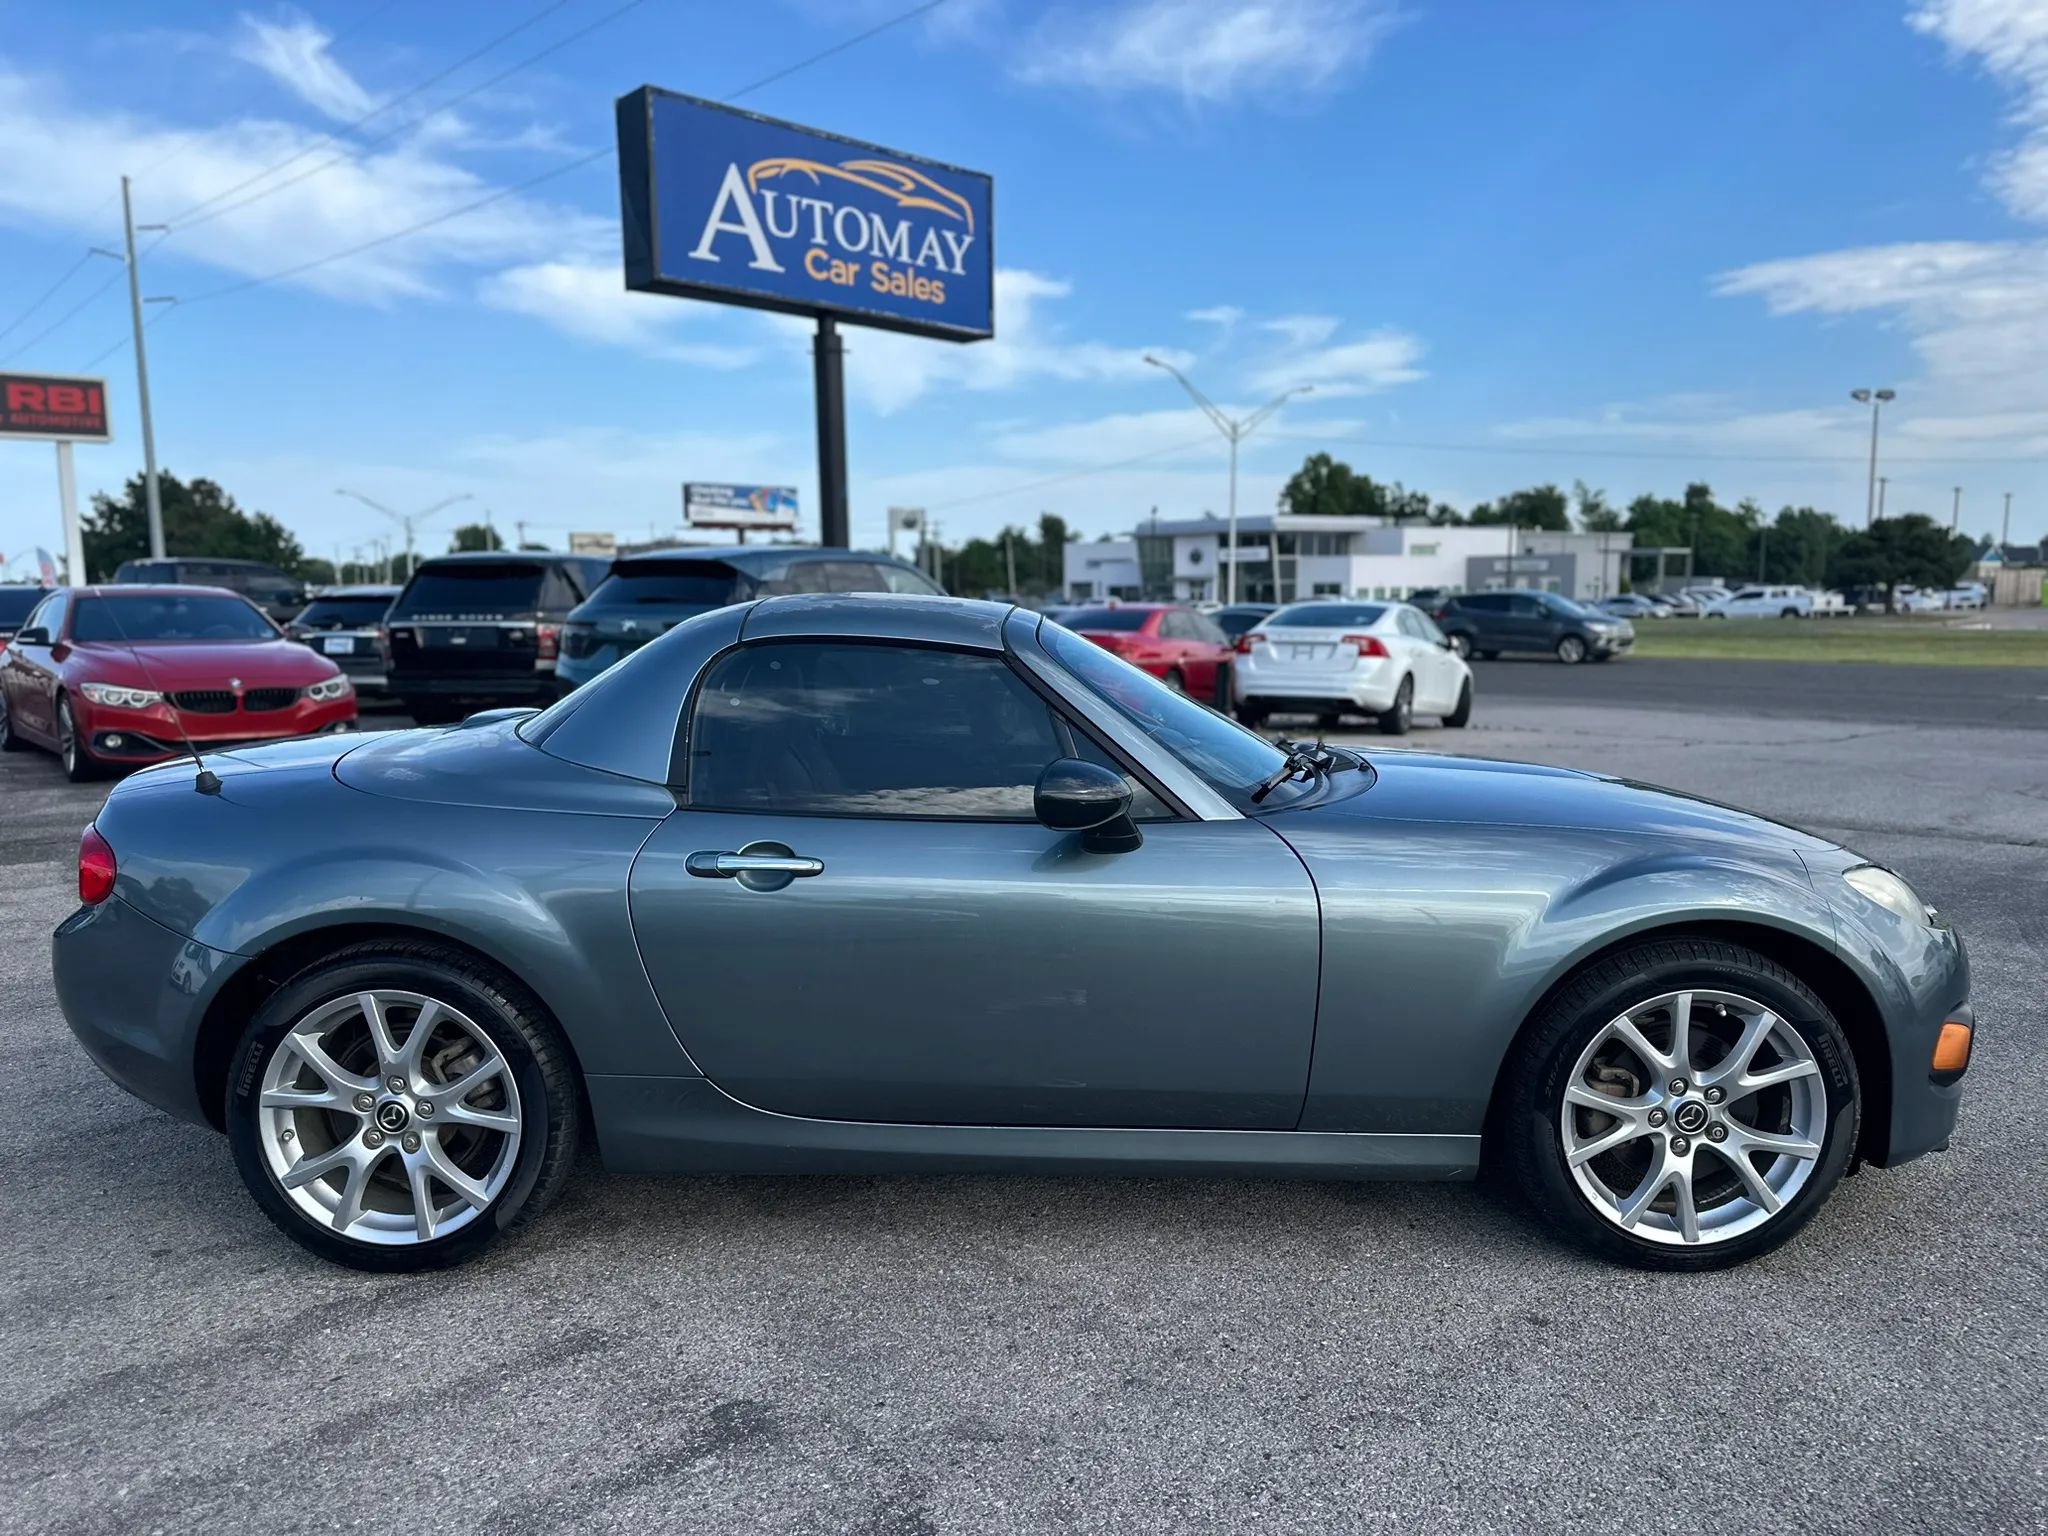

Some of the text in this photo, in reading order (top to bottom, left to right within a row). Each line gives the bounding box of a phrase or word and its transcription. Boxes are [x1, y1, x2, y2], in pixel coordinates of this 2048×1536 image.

[804, 248, 946, 305] Car Sales
[6, 382, 102, 415] RBI
[236, 1040, 264, 1097] PIRELLI
[1817, 1033, 1849, 1088] PIRELLI
